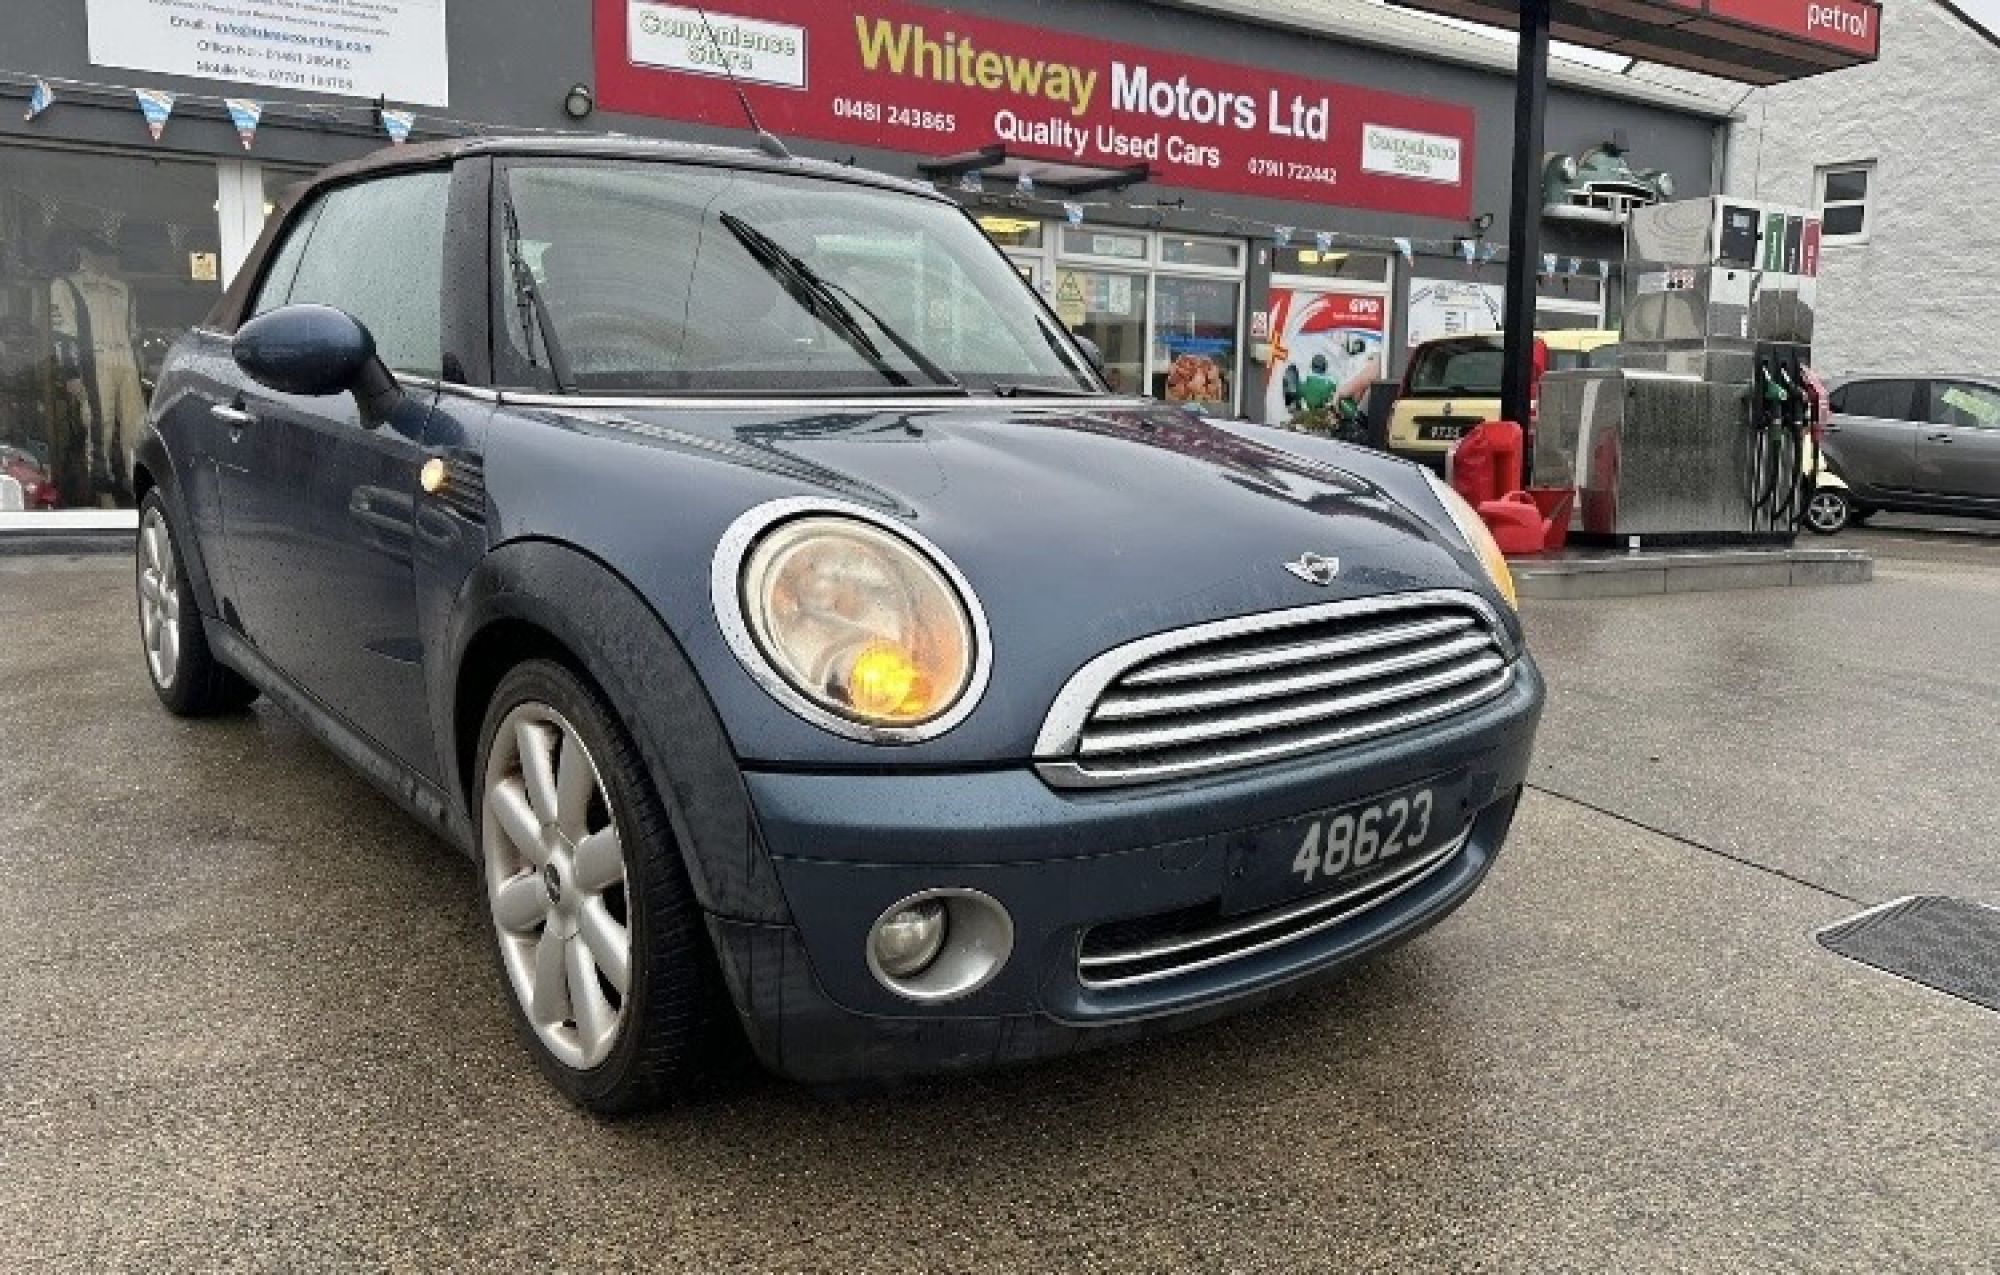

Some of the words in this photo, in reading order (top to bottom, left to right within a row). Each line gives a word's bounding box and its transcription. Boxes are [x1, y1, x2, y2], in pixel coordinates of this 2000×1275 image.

[640, 10, 795, 57] Convenience
[1807, 4, 1868, 38] petrol
[687, 43, 753, 71] Store
[855, 15, 1097, 116] Whiteway
[1111, 60, 1257, 129] Motors
[1268, 88, 1329, 142] Ltd
[832, 97, 881, 121] 01481
[887, 106, 956, 133] 243865
[994, 109, 1088, 156] Quality
[1096, 124, 1160, 160] Used
[1167, 135, 1221, 168] Cars
[1248, 157, 1284, 177] 07911
[1287, 162, 1337, 184] 722442
[1292, 788, 1433, 884] 48623
